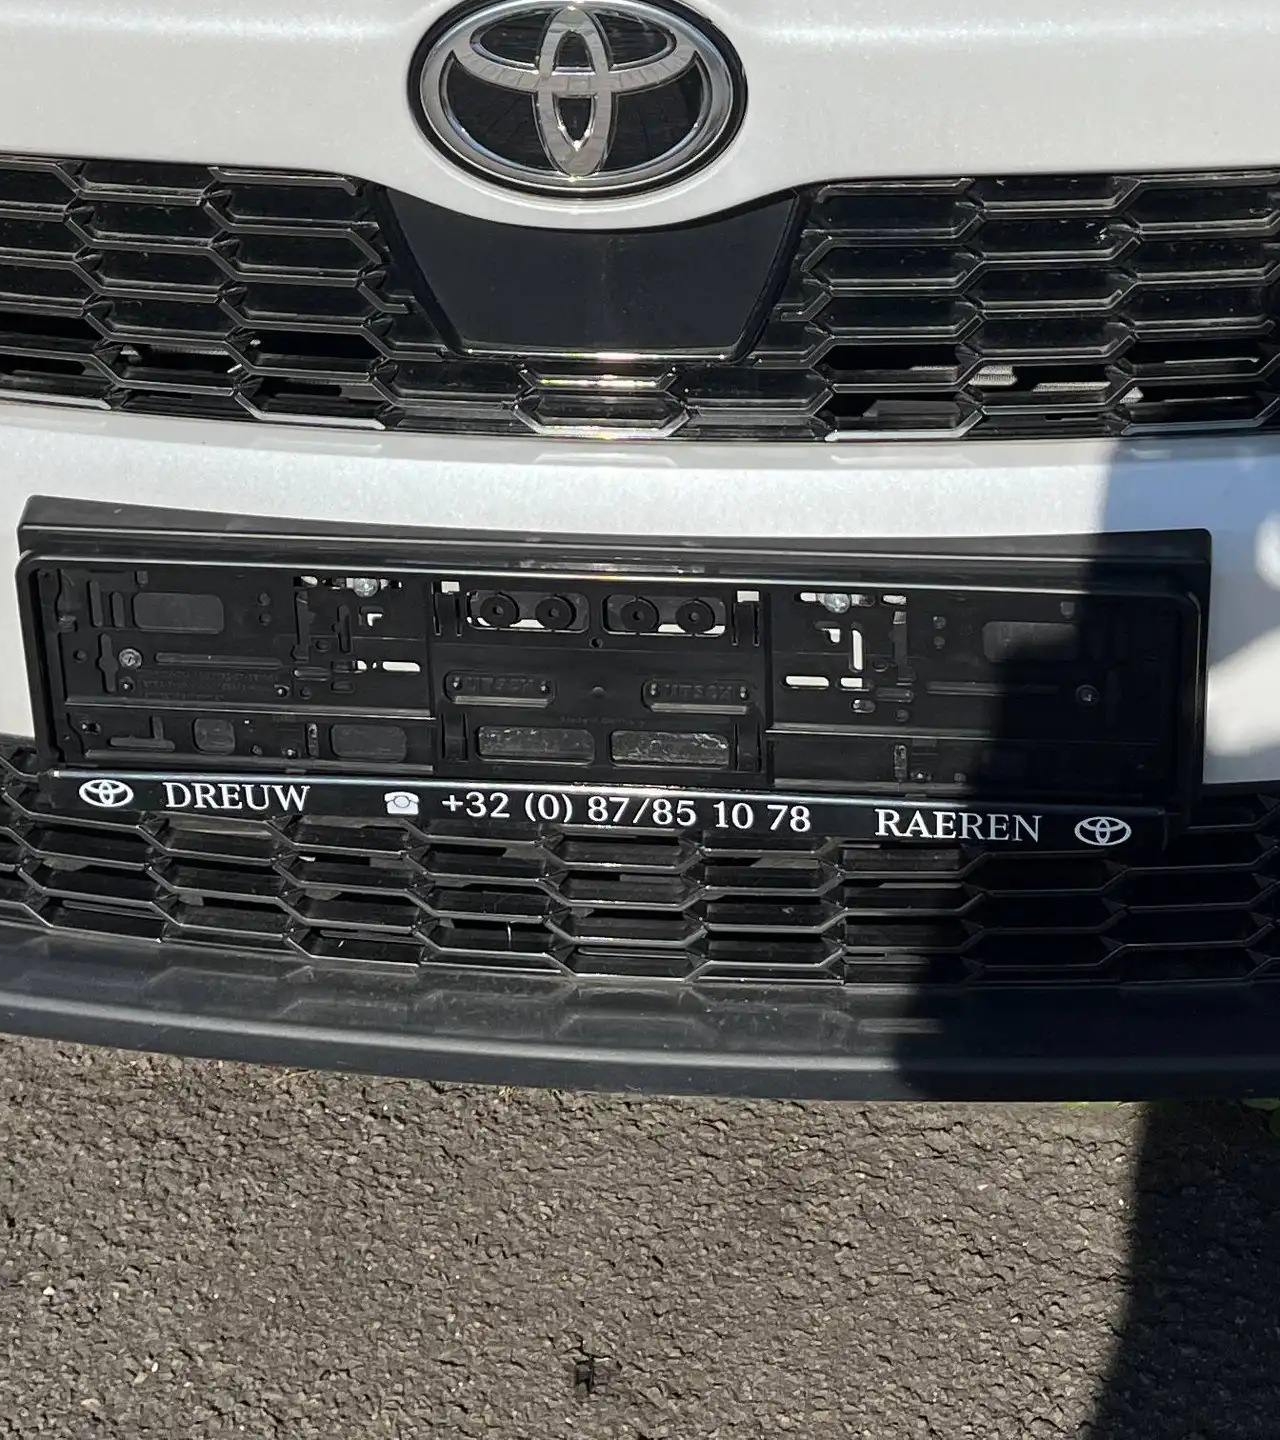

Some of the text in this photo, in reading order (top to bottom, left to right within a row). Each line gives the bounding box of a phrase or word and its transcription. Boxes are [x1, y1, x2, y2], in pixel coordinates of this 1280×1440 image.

[161, 781, 1043, 843] DREUW +32 (0) 87/85 10 78 RAEREN
